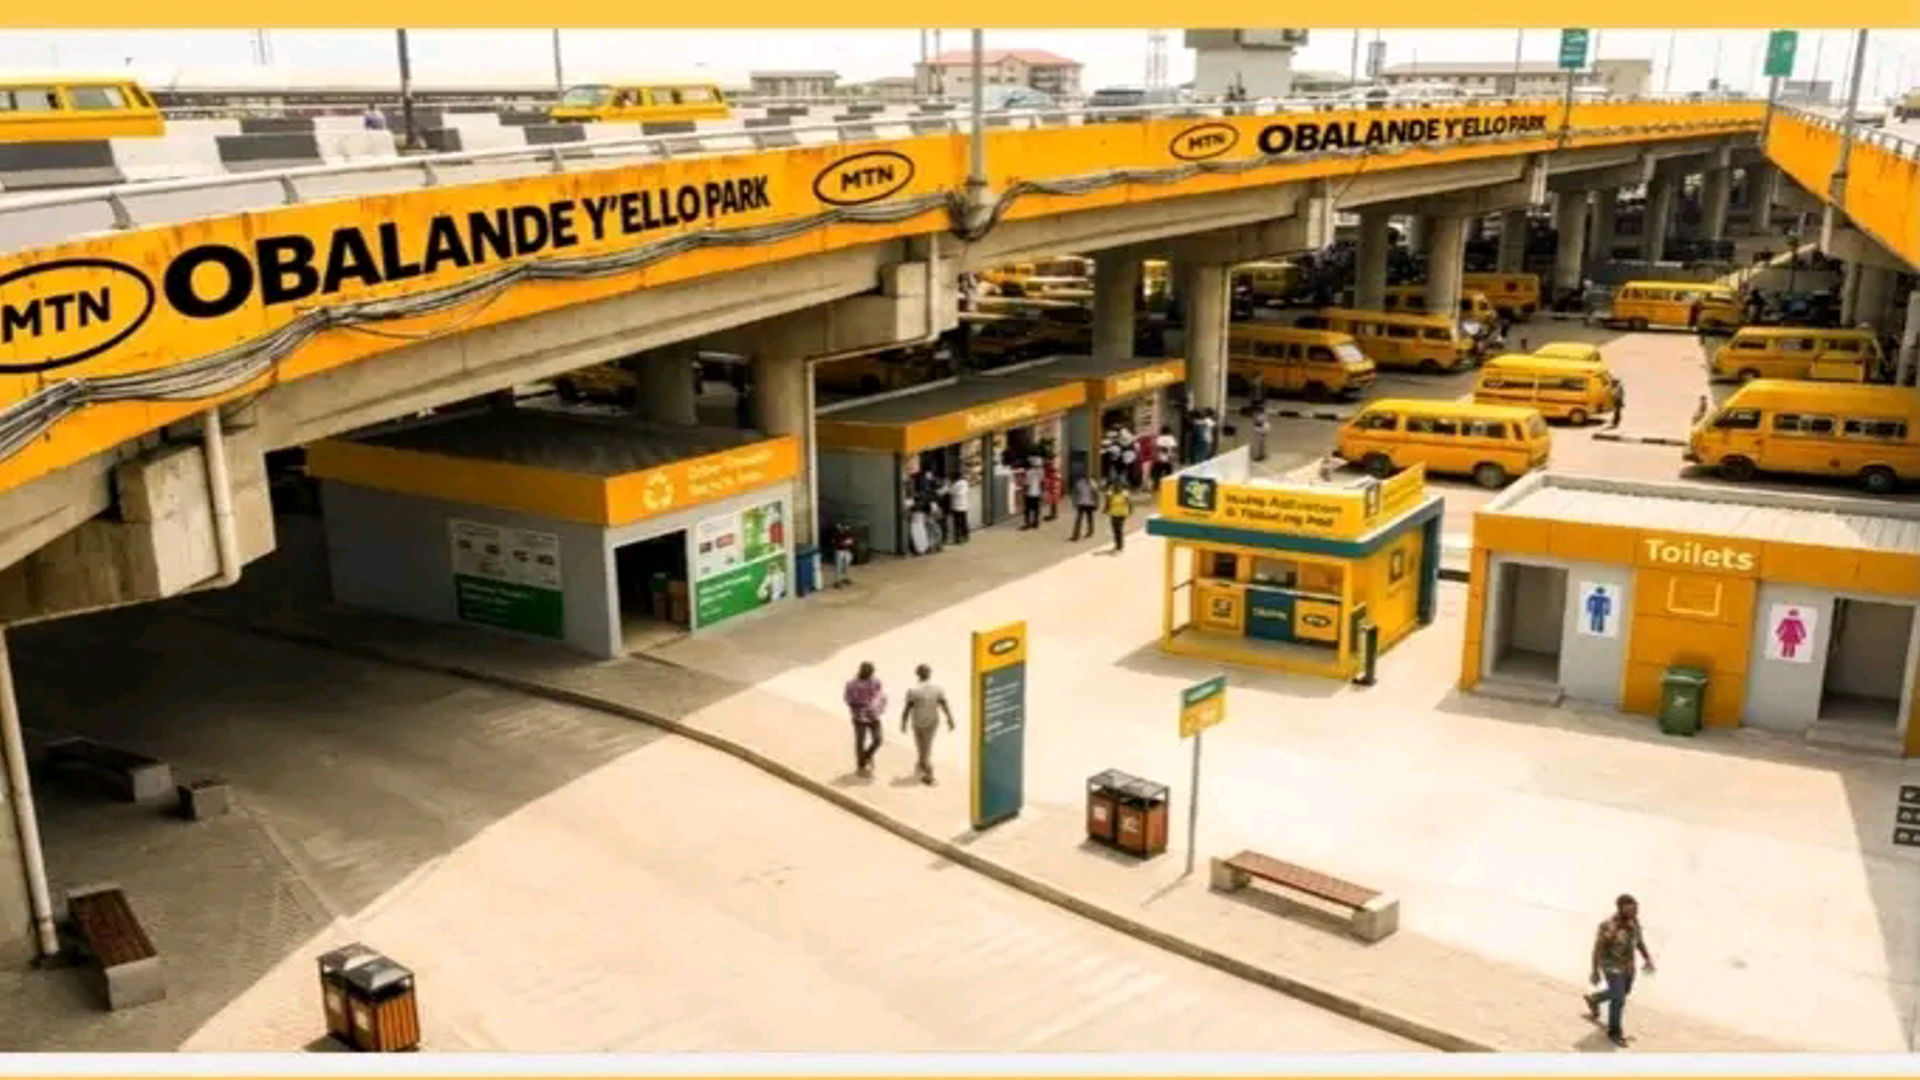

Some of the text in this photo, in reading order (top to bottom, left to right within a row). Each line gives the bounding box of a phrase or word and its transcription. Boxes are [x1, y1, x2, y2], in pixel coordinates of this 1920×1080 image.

[1188, 131, 1226, 151] MTN
[1257, 114, 1547, 157] OBALANDE Y'ELLO PARK
[840, 164, 894, 191] MTN
[163, 177, 770, 318] OBALANDE Y'ELLO PARK
[1, 287, 110, 343] MTN
[1644, 539, 1755, 571] Toilets
